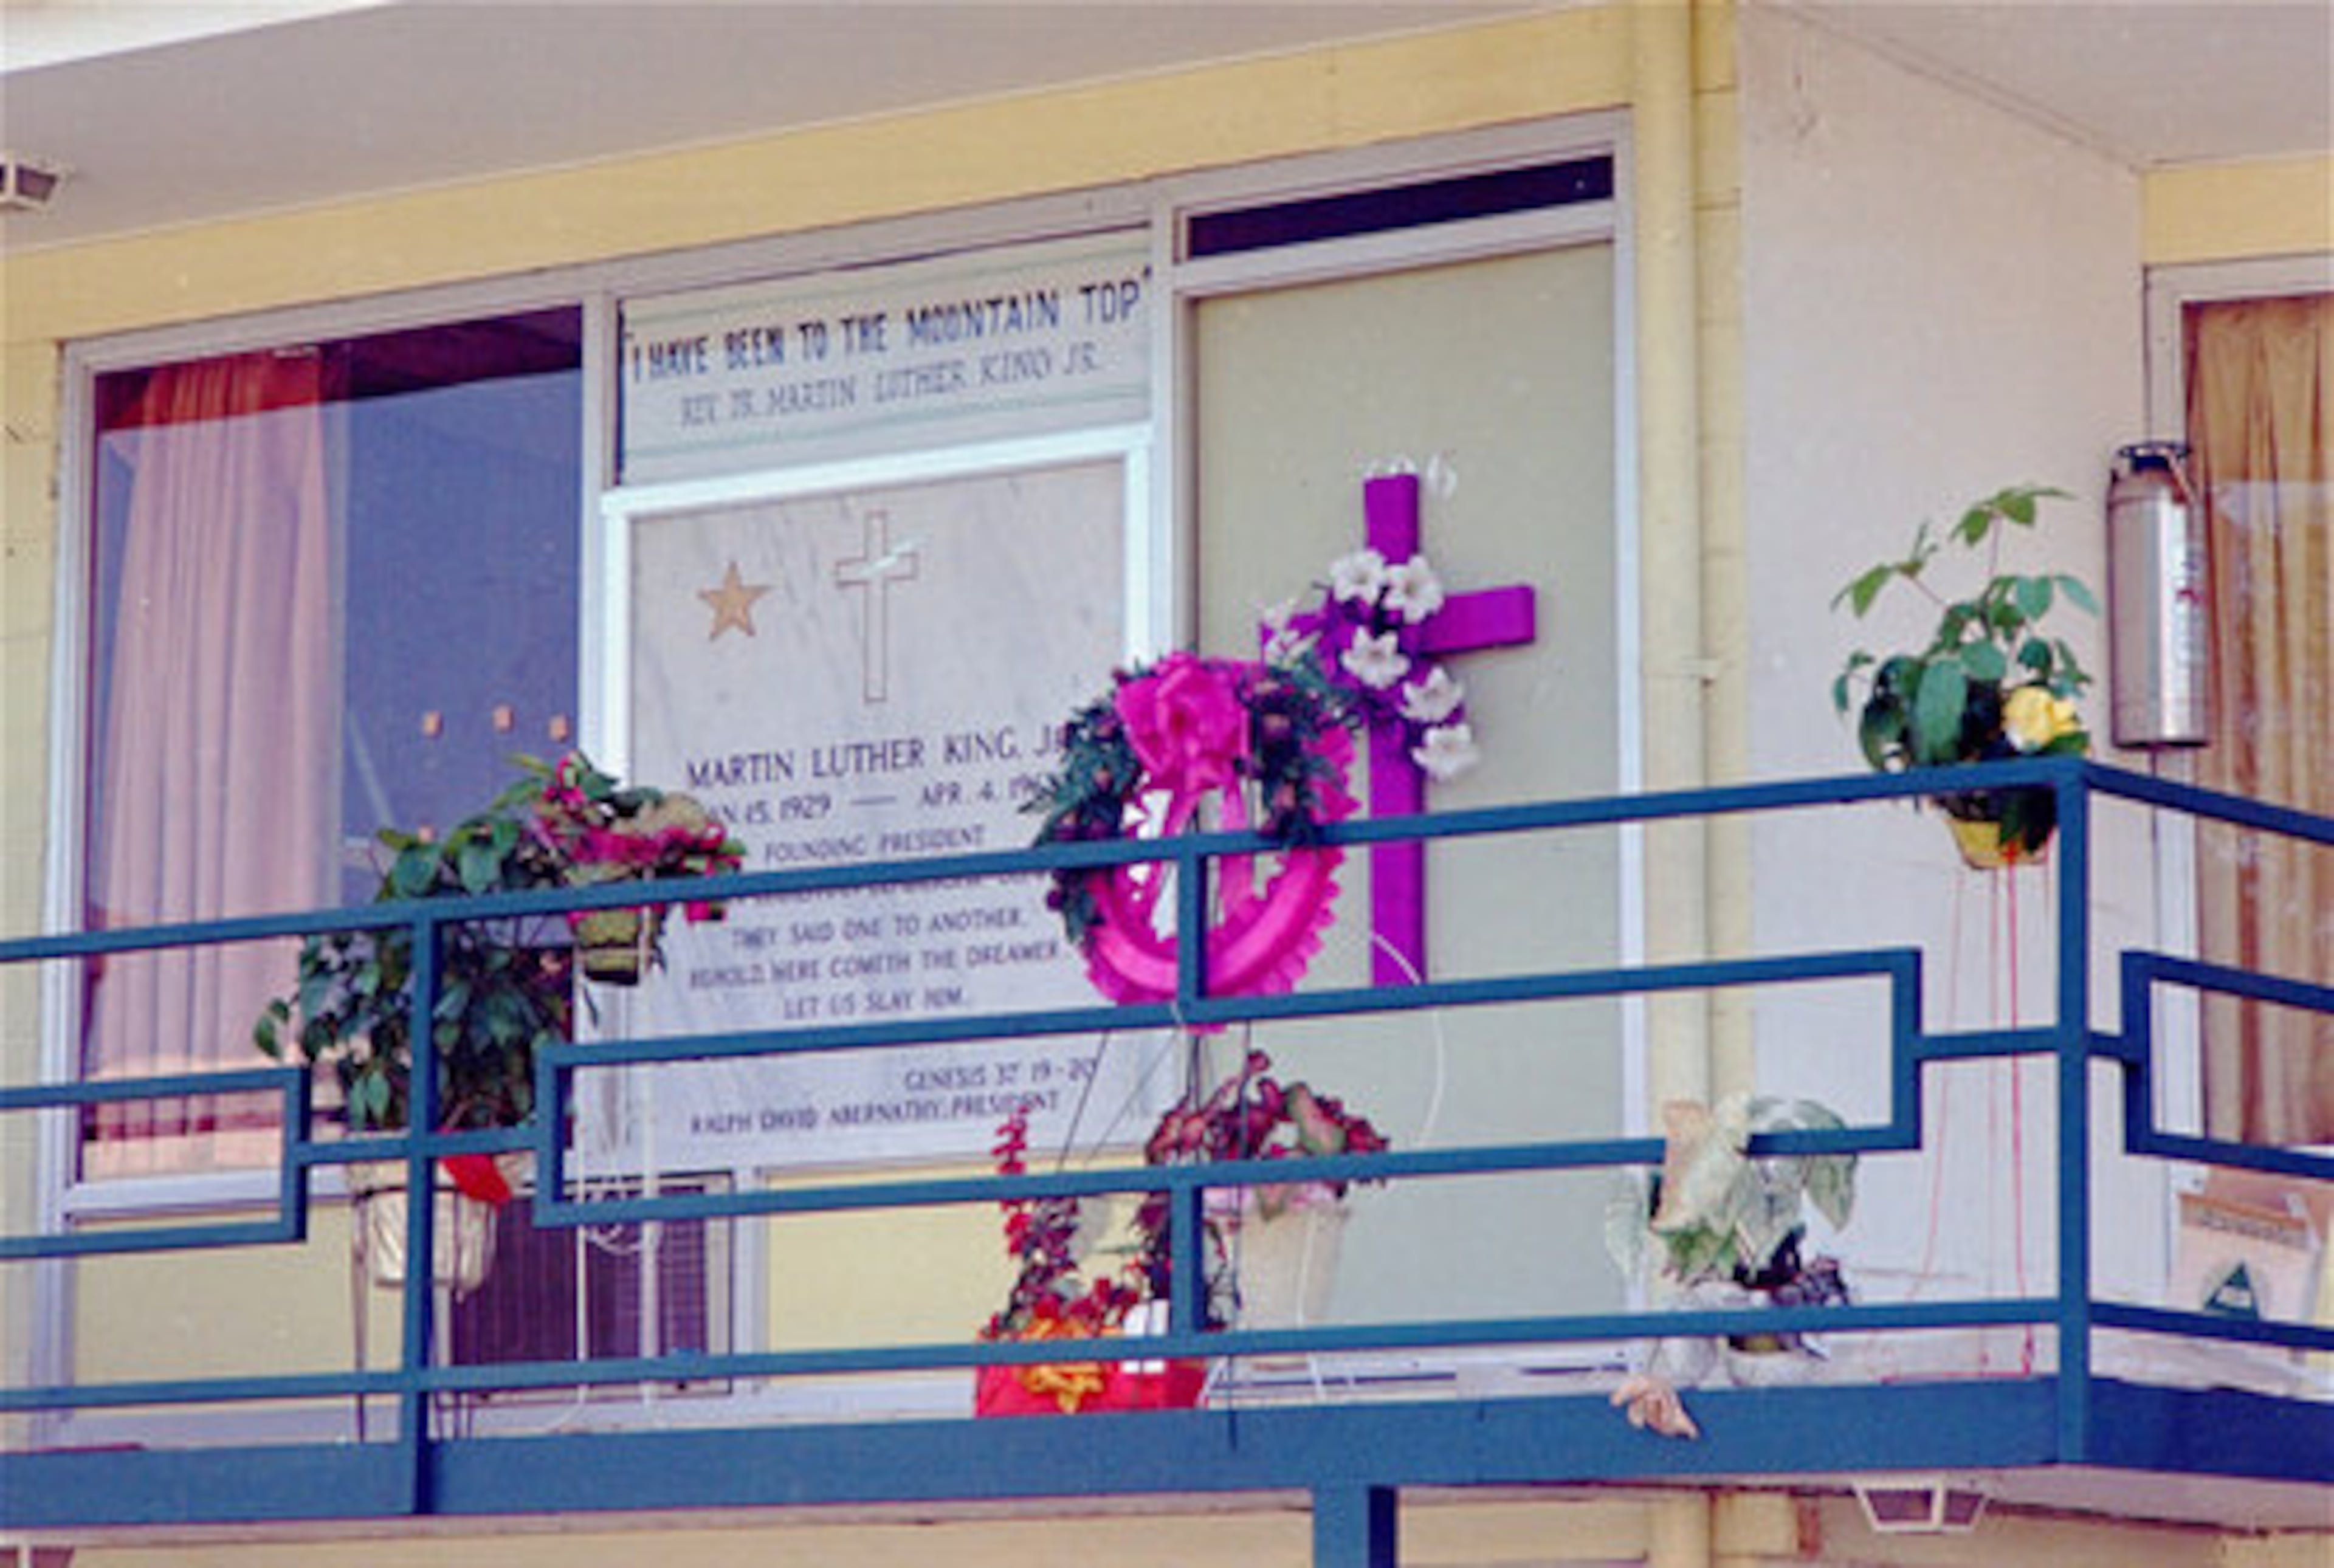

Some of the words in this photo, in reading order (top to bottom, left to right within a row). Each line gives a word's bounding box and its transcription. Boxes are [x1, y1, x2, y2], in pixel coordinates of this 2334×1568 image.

[649, 335, 709, 379] HAVE
[725, 326, 785, 370] BEEN
[797, 320, 827, 360] TO
[840, 312, 887, 354] THE
[907, 289, 1059, 346] MOUNTAIN
[767, 375, 856, 417] MARTIN
[874, 360, 966, 403] LUTHER
[979, 348, 1052, 386] KING
[687, 749, 794, 787] MARTIN
[812, 738, 925, 778] LUTHER
[780, 793, 831, 822] 1929
[765, 834, 866, 864] FOUNDING
[880, 824, 985, 852] PRESIDENT
[732, 926, 777, 949] THEY
[791, 920, 835, 943] SAID
[842, 916, 880, 940] ONE
[895, 913, 920, 937] TO
[830, 953, 911, 978] COMETH
[922, 949, 955, 969] THE
[783, 995, 821, 1020] LET
[829, 991, 856, 1016] US
[866, 989, 912, 1012] SLAY
[904, 1065, 986, 1091] GENESIS
[691, 1113, 752, 1134] RALPH
[760, 1107, 818, 1131] DAVID
[952, 1091, 1060, 1119] PRESIDENT
